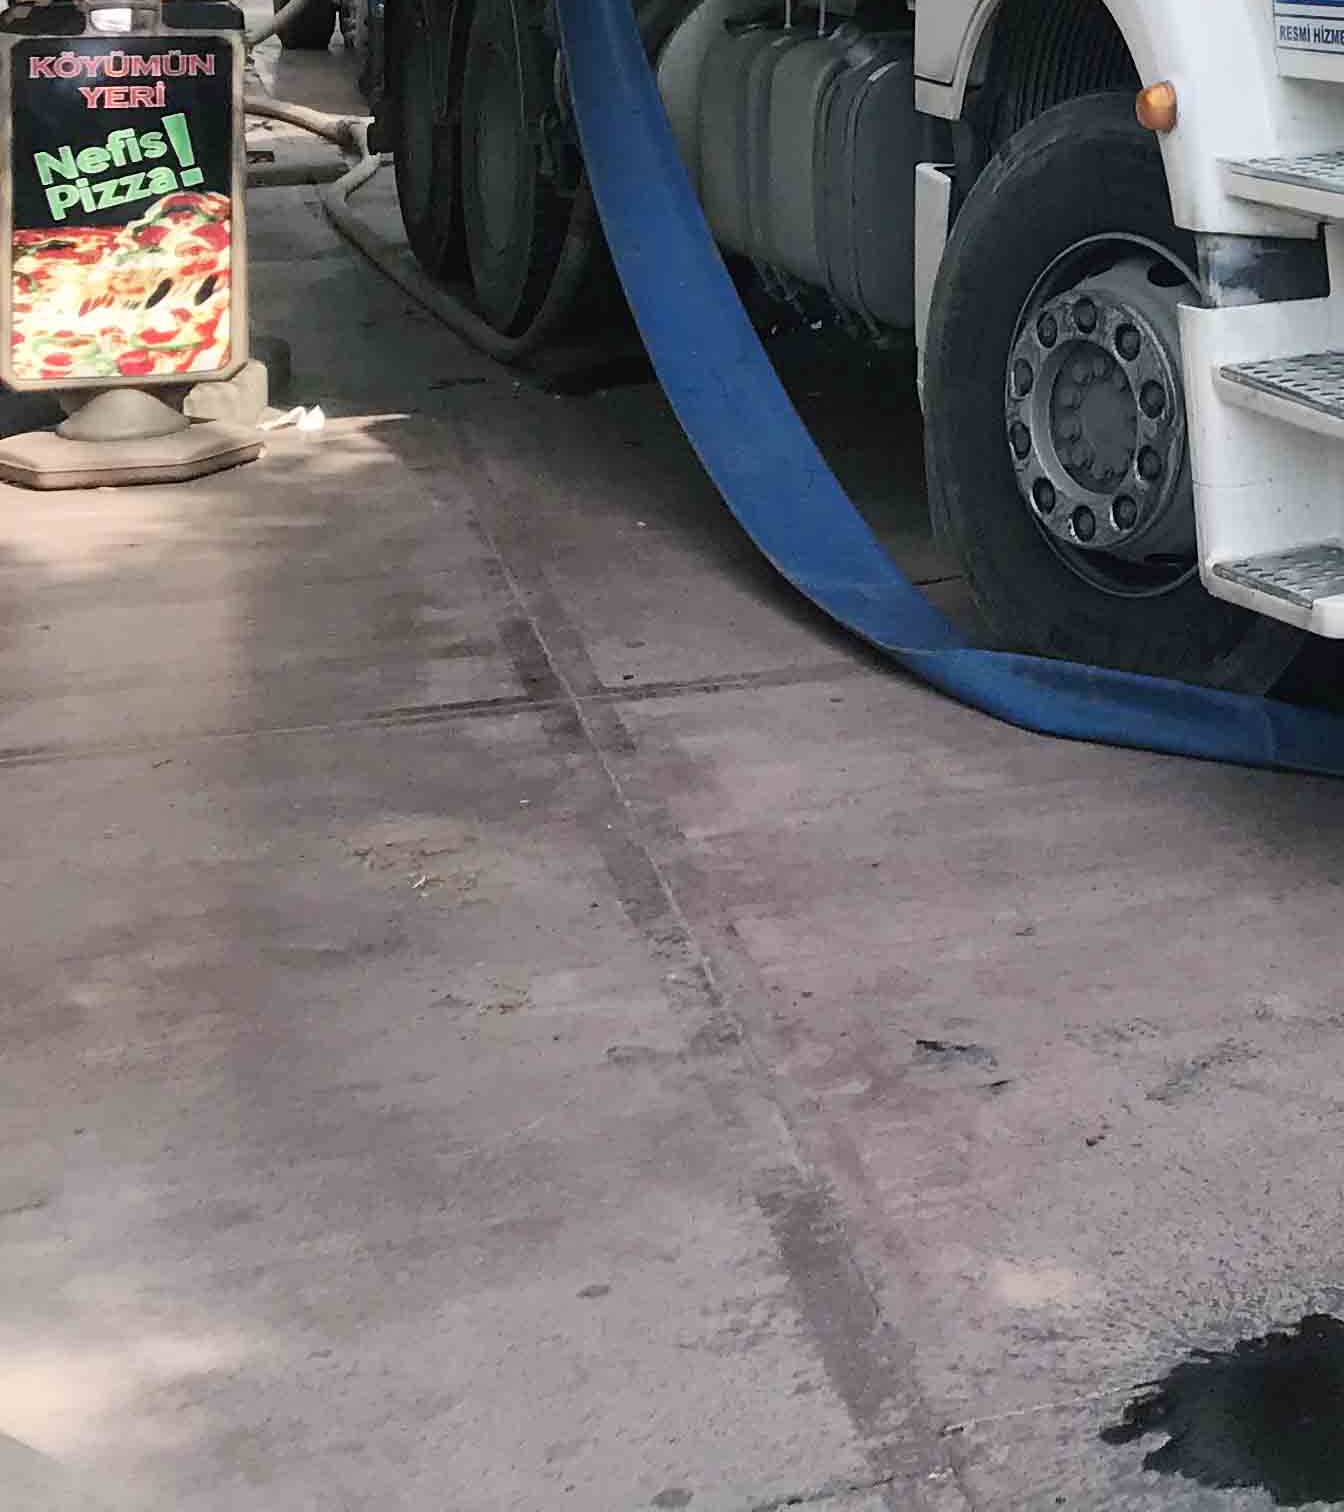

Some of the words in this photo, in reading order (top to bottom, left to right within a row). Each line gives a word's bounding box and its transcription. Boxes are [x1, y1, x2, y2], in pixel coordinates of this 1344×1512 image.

[1280, 23, 1311, 44] RESMİ
[29, 49, 216, 80] KÖYÜMÜN
[78, 80, 167, 111] YERİ
[34, 127, 169, 187] Nefis
